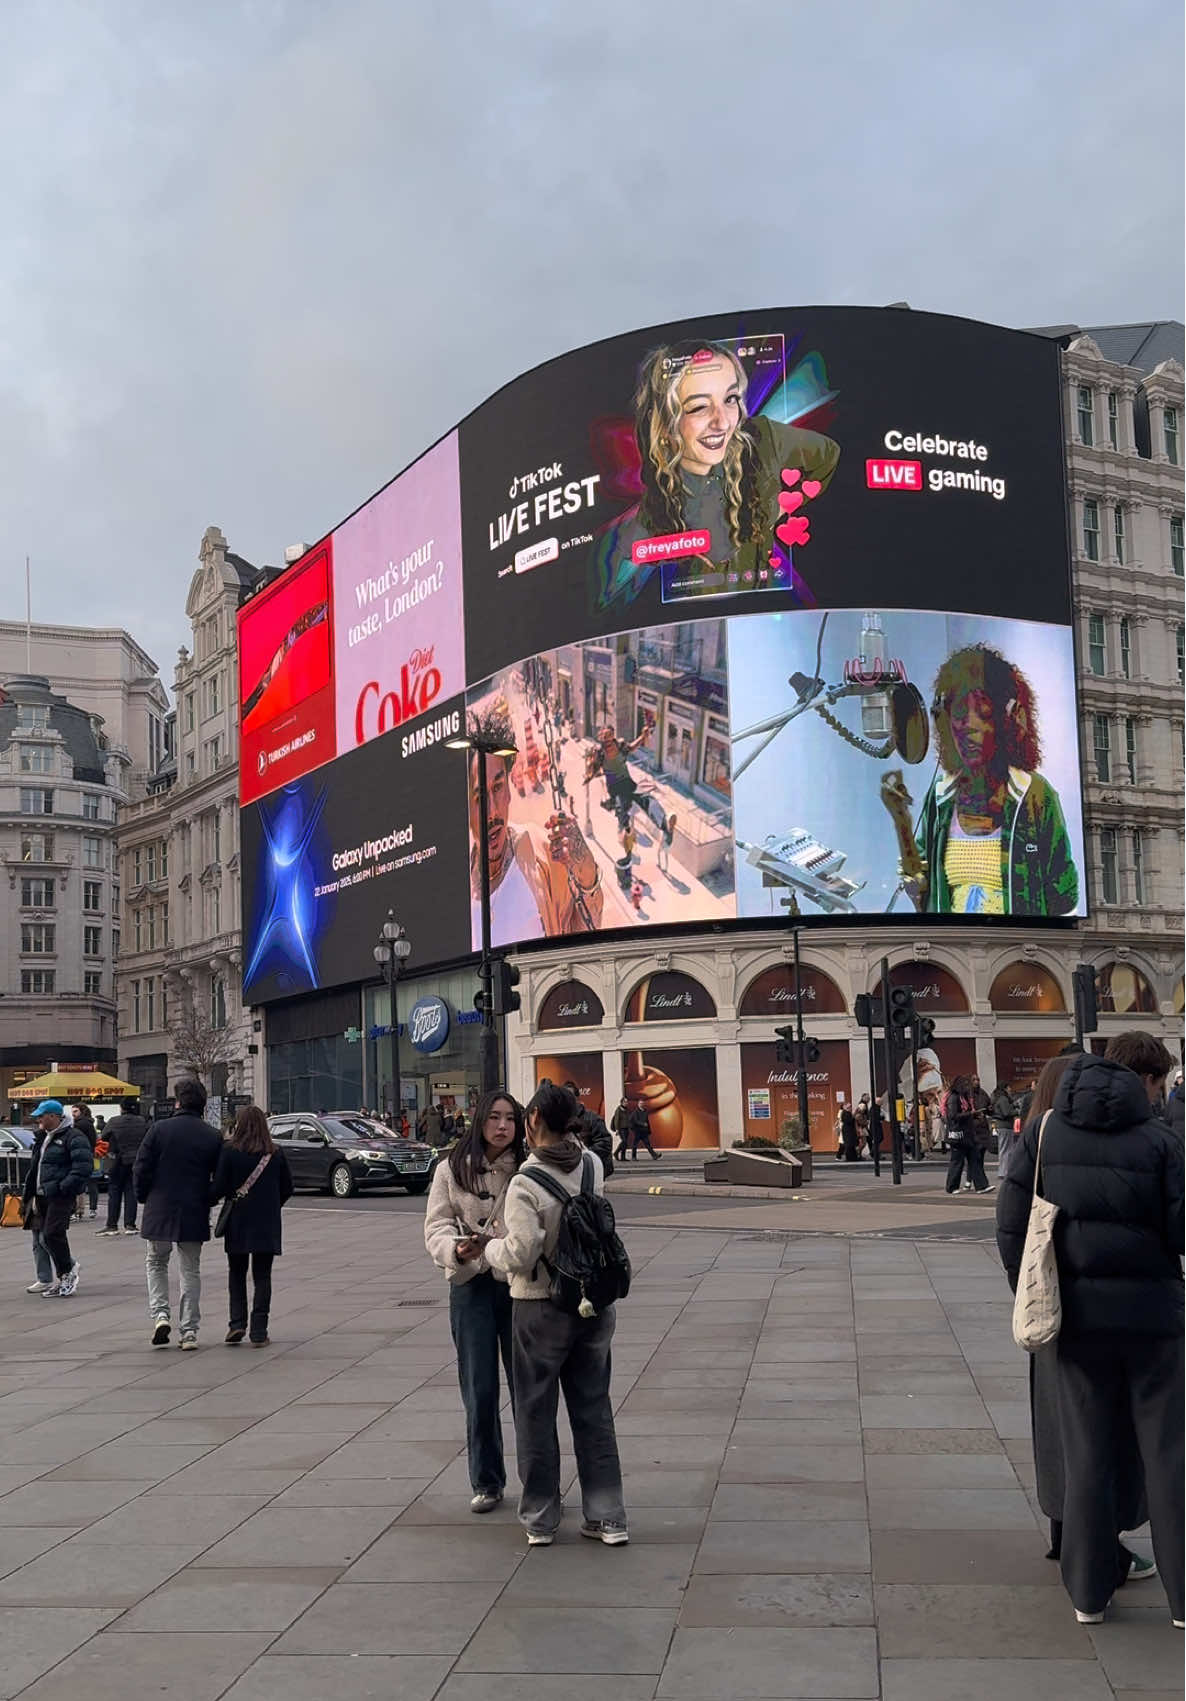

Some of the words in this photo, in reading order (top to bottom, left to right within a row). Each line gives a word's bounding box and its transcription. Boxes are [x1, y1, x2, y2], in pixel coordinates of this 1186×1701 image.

[884, 430, 988, 461] Celebrate
[520, 462, 563, 493] TikTok
[872, 465, 916, 484] LIVE
[928, 470, 1005, 500] gaming
[489, 501, 530, 551] LIVE
[534, 474, 600, 526] FEST
[538, 547, 552, 559] FEST
[570, 534, 594, 547] TikTok
[636, 537, 705, 558] @freyafoto
[355, 561, 398, 610] What's
[401, 539, 434, 585] your
[348, 612, 383, 648] taste,
[385, 560, 444, 624] London?
[410, 645, 435, 674] Diet
[355, 664, 442, 745] Coke
[401, 711, 460, 759] SAMSUNG
[332, 847, 363, 871] Galaxy
[364, 824, 413, 861] Unpacked
[395, 846, 437, 869] samsung.com
[650, 994, 683, 1008] Lindt
[1008, 984, 1036, 998] Lindt
[411, 1004, 441, 1043] Boots
[557, 1003, 581, 1016] Lindt
